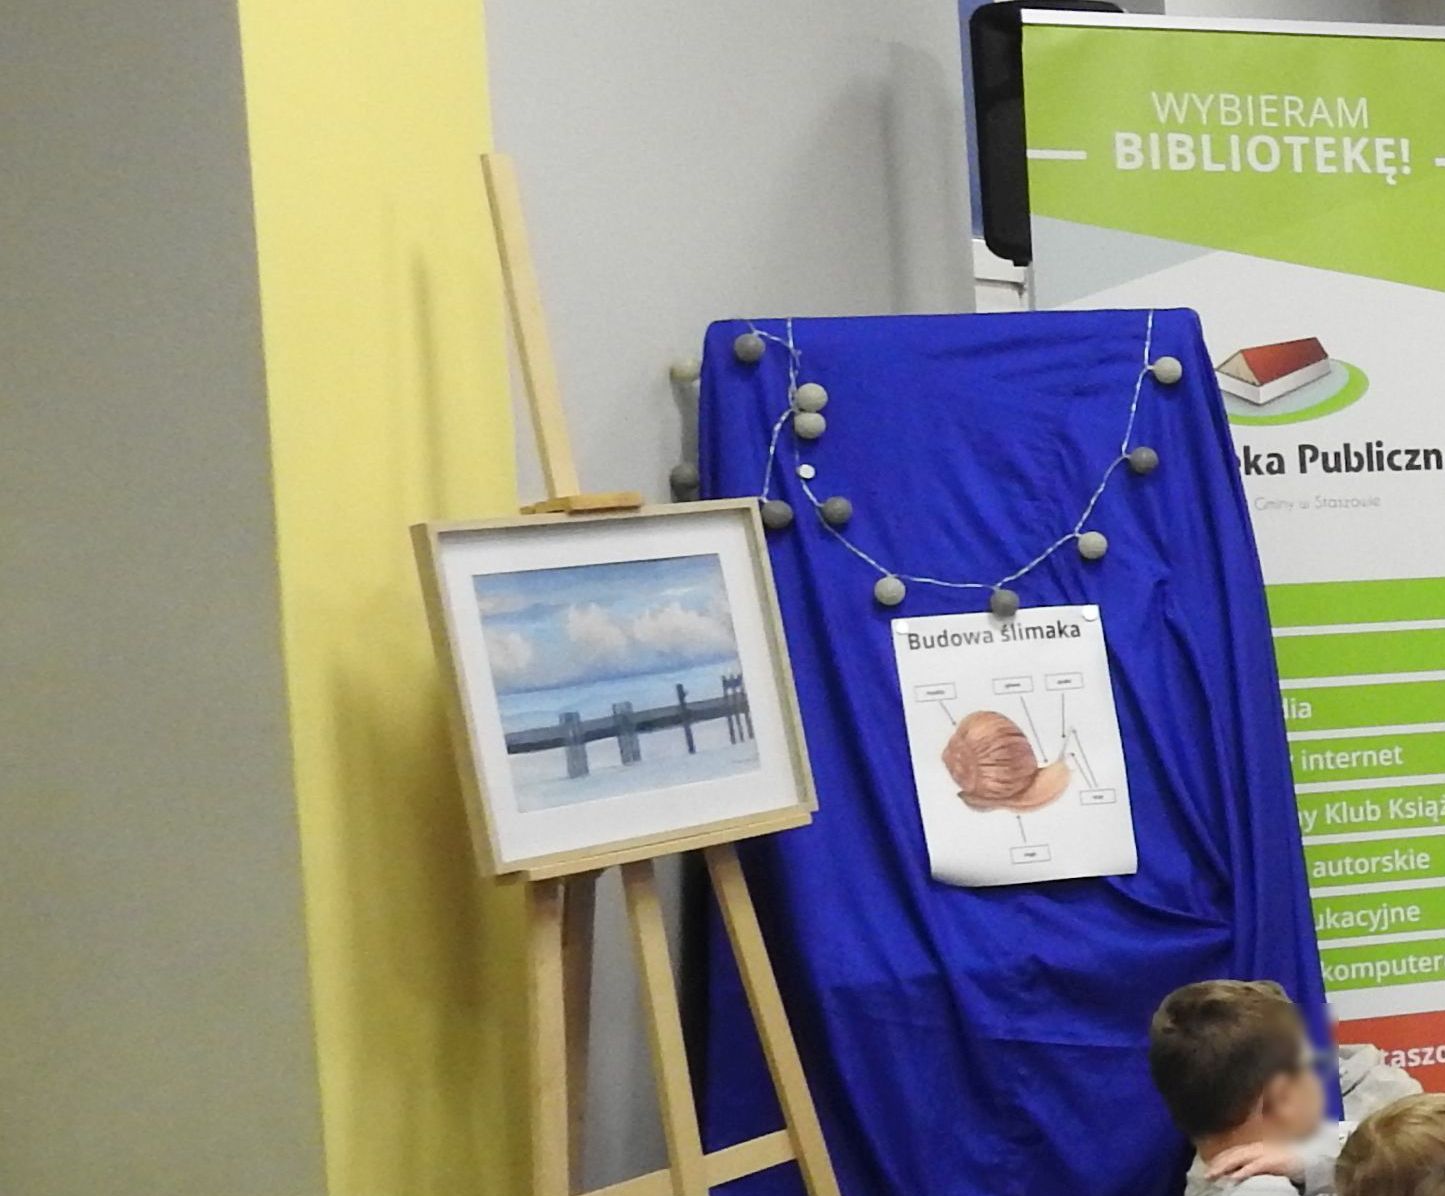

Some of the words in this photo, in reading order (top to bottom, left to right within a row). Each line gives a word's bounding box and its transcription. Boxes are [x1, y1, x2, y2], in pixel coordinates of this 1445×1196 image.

[1151, 91, 1369, 129] WYBIERAM
[1114, 131, 1411, 185] BIBLIOTEKĘ!
[1239, 445, 1286, 476] ka
[907, 628, 994, 651] Budowa
[1000, 620, 1082, 643] ślimaka
[1301, 745, 1404, 772] internet
[1325, 799, 1381, 825] Klub
[1312, 848, 1431, 878] autorskie
